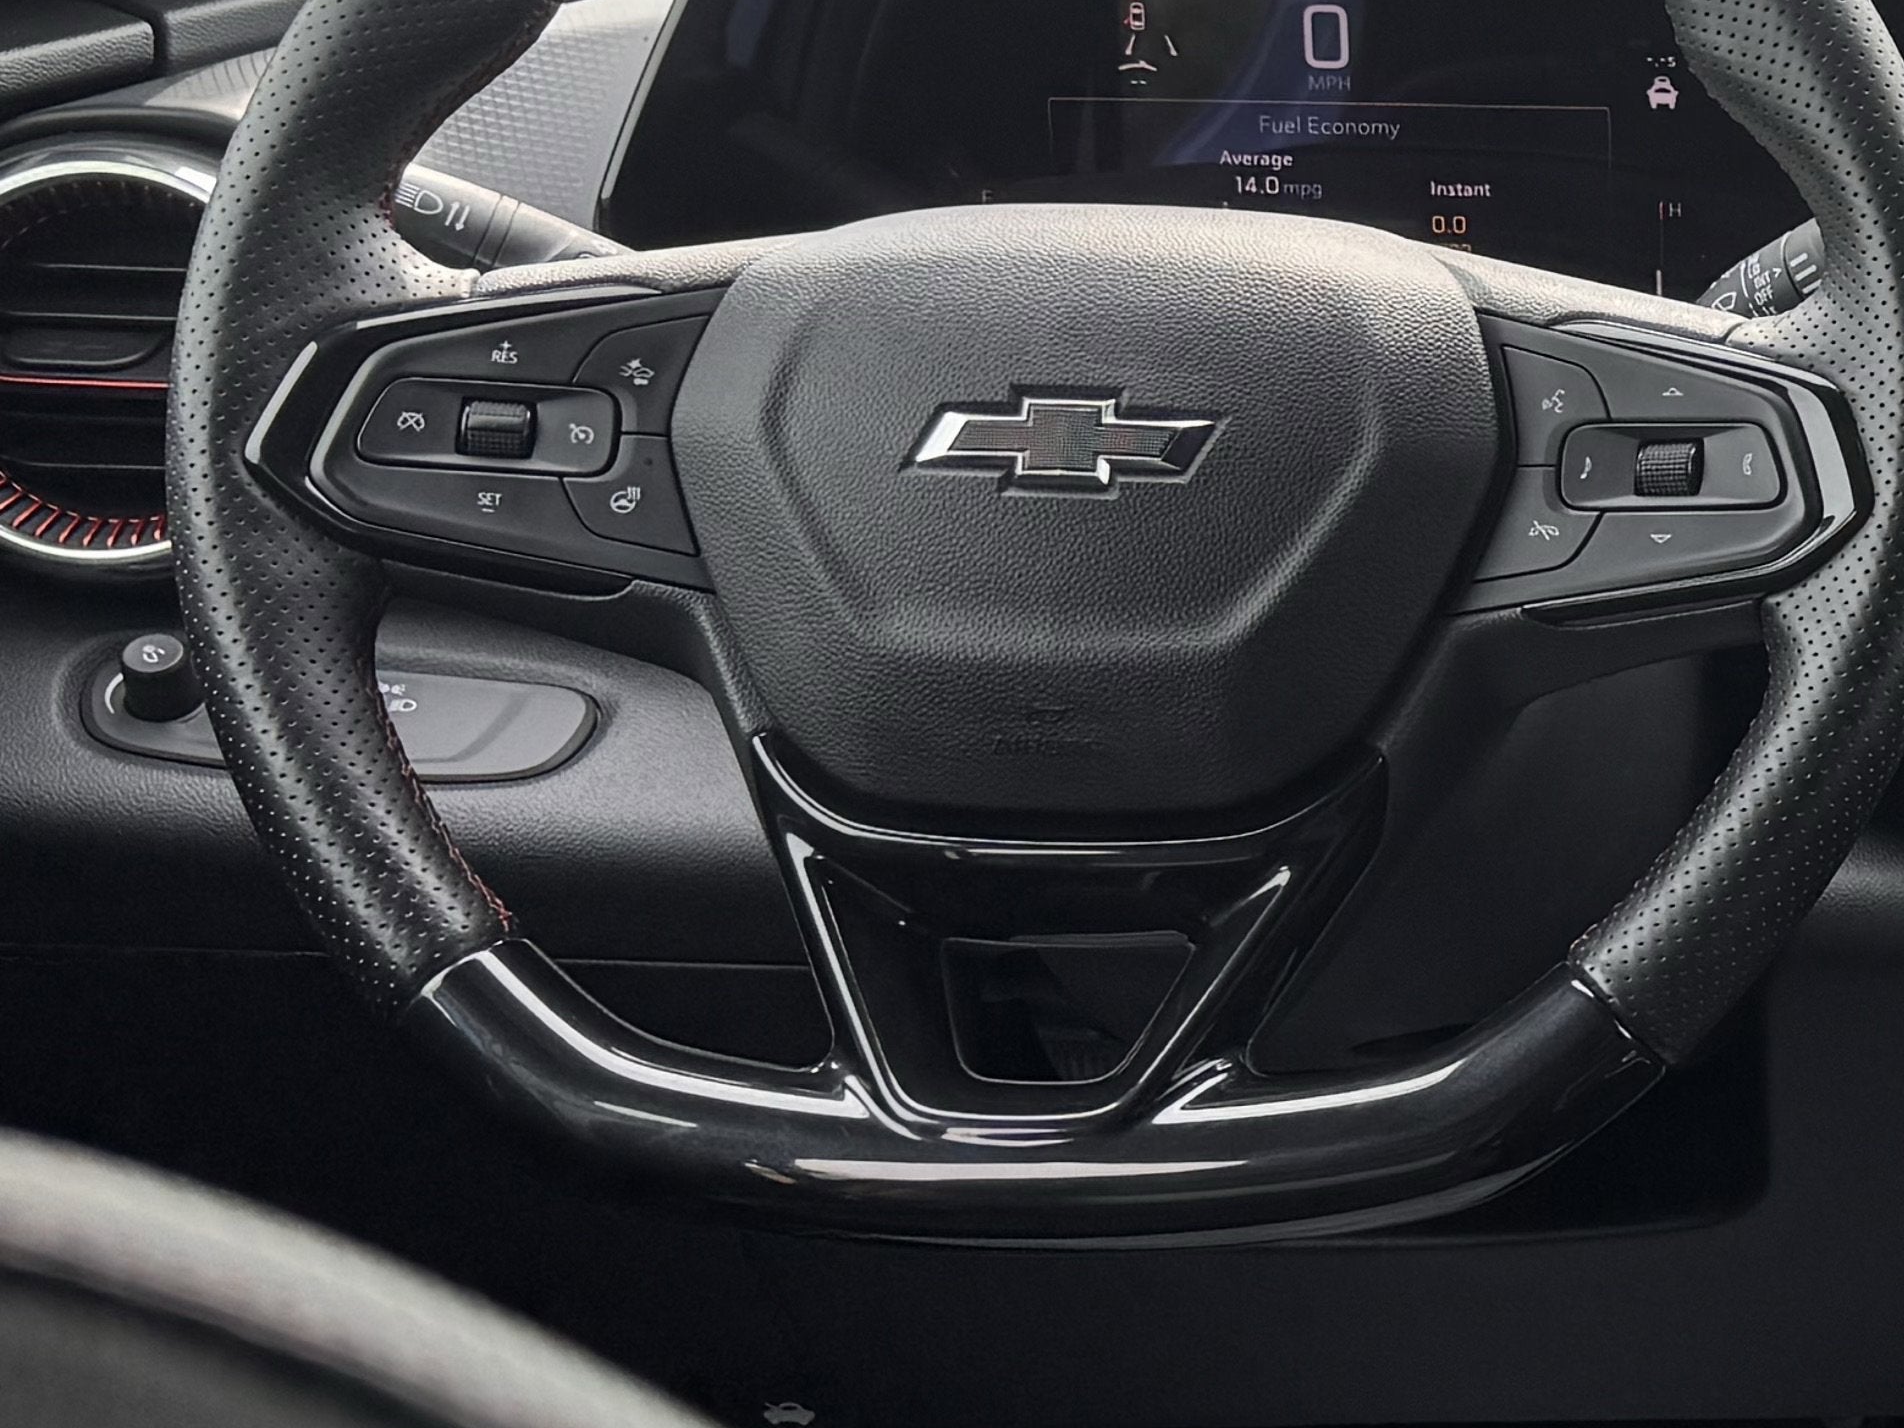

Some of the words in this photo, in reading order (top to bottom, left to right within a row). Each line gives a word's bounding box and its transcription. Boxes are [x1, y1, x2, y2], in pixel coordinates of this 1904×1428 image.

[1302, 4, 1350, 69] 0
[1308, 74, 1351, 91] MPH
[1259, 115, 1301, 134] Fuel
[1307, 115, 1401, 140] Economy
[1219, 149, 1293, 171] Average
[1235, 175, 1280, 195] 14.0
[1283, 183, 1323, 199] mpg
[1430, 181, 1491, 197] Instant
[1668, 202, 1683, 218] H
[1431, 215, 1467, 234] 0.0
[491, 349, 519, 364] RES
[476, 491, 503, 508] SET
